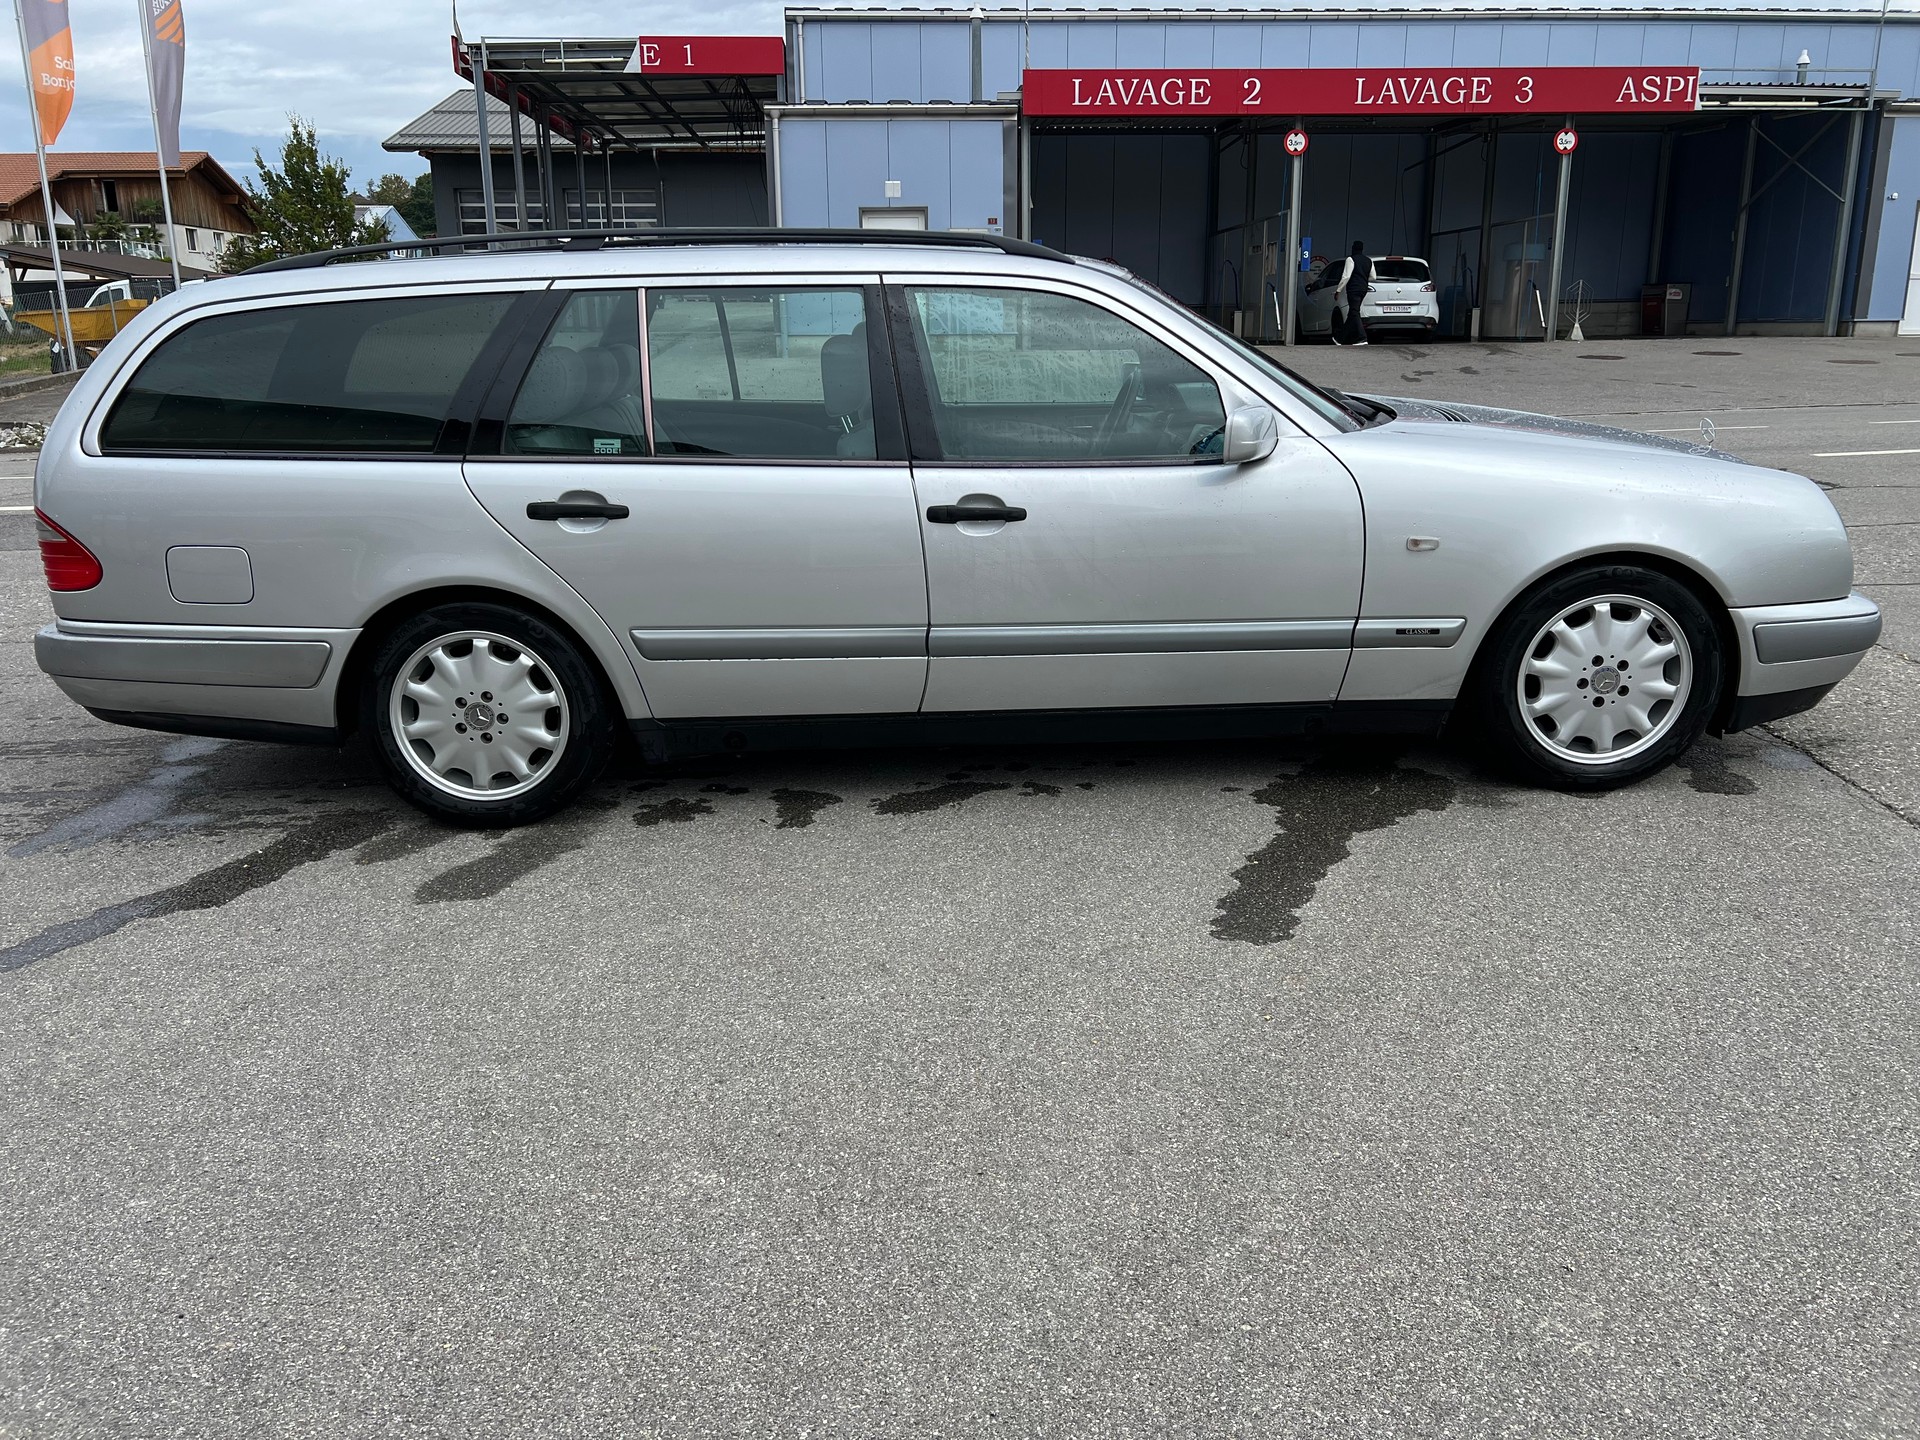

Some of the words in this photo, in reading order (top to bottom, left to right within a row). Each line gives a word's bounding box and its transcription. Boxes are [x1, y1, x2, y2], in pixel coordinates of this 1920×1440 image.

[641, 43, 660, 66] E
[683, 44, 694, 66] 1
[1072, 78, 1212, 106] LAVAGE
[1242, 77, 1262, 105] 2
[1354, 76, 1492, 105] LAVAGE
[1514, 76, 1533, 104] 3
[1615, 75, 1697, 103] ASPI
[1303, 250, 1309, 258] 3
